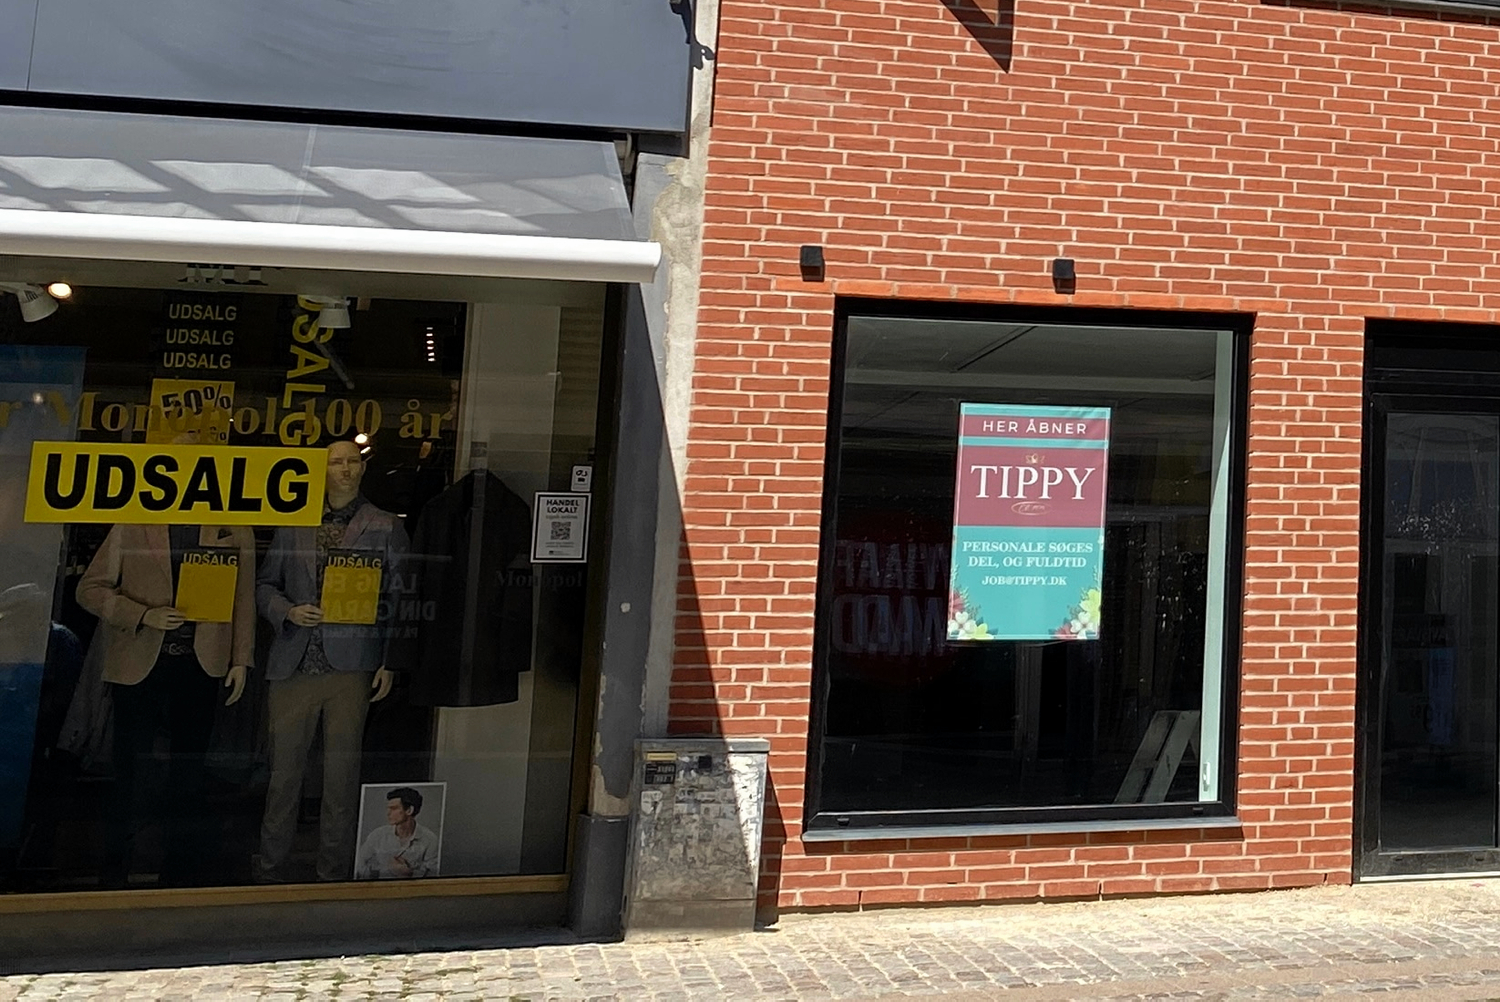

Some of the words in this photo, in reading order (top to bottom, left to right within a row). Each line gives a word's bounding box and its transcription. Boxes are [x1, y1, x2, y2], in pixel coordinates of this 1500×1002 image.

[168, 303, 238, 321] UDSALG
[166, 328, 235, 346] UDSALG
[163, 352, 232, 369] UDSALG
[299, 398, 382, 438] 100
[399, 398, 453, 440] år
[982, 420, 1019, 433] HER
[1025, 418, 1087, 435] ÅBNER
[43, 452, 311, 515] UDSALG
[970, 464, 1096, 500] TIPPY
[546, 499, 580, 507] HANDEL
[547, 506, 578, 514] LOKALT
[962, 541, 1046, 553] PERSONALE
[1048, 542, 1094, 553] SØGES
[968, 556, 1000, 569] DEL,
[1002, 556, 1023, 568] OG
[1025, 557, 1087, 568] FULDTID
